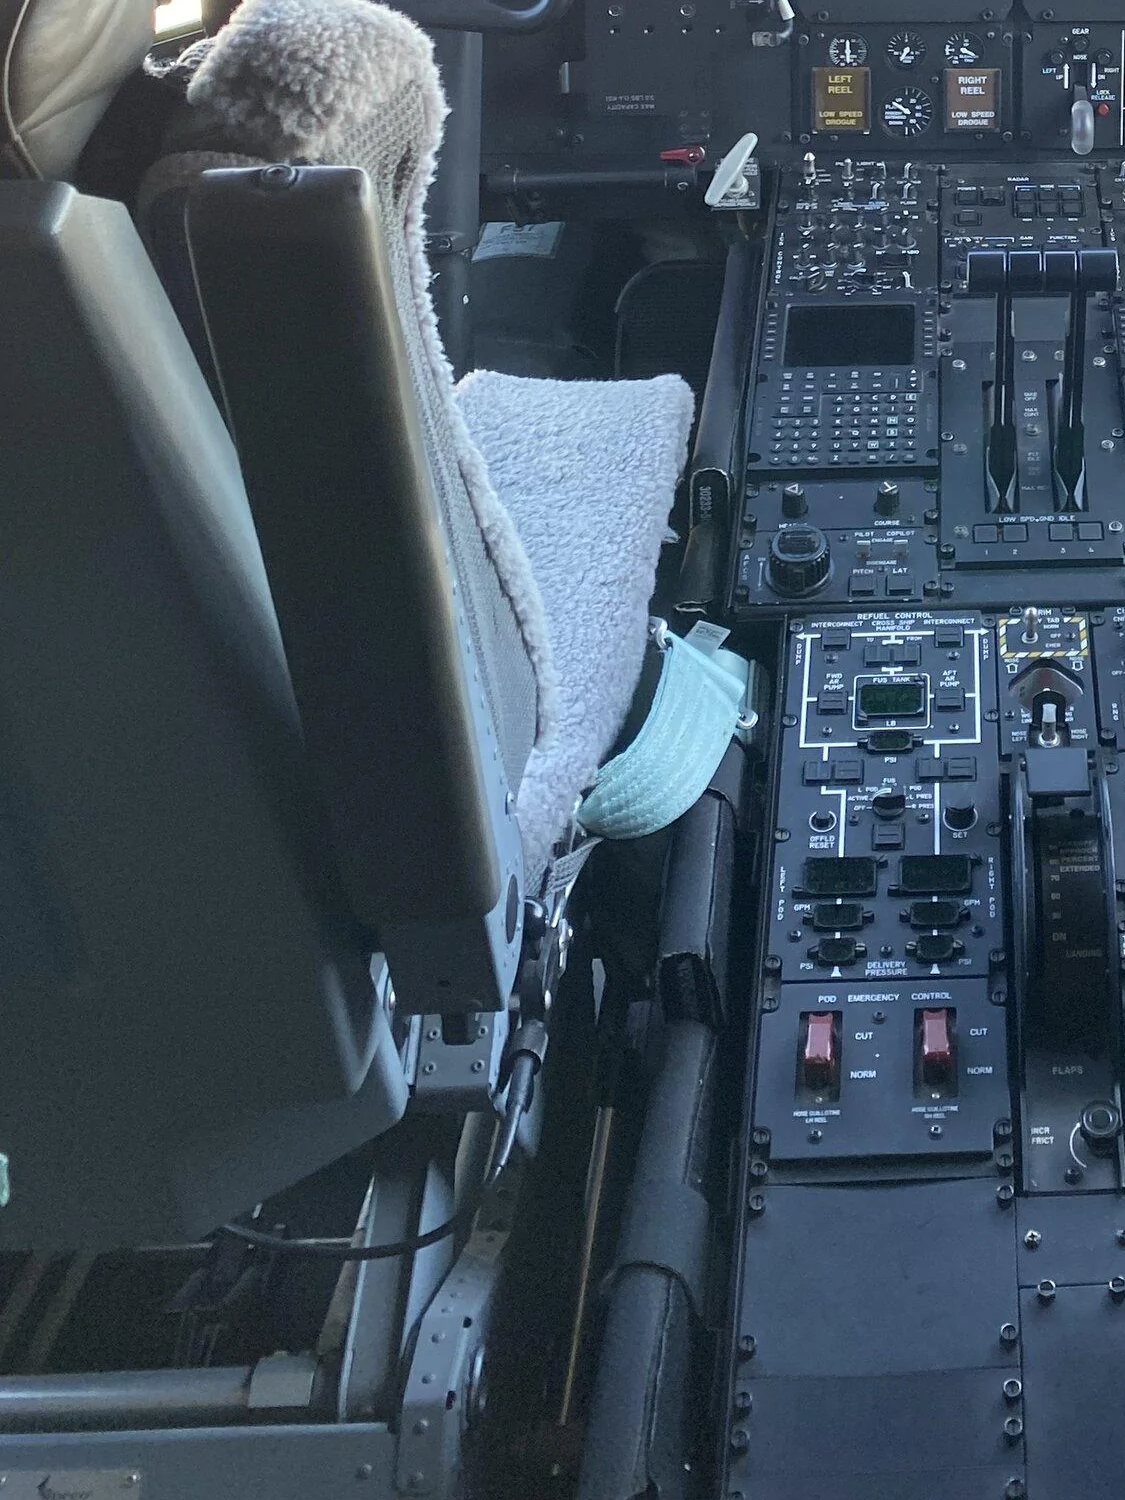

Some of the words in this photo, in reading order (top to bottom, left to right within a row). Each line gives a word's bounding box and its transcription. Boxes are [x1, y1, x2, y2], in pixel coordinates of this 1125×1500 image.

[1071, 27, 1090, 35] GEAR
[828, 75, 853, 84] LEFT
[957, 76, 988, 85] RIGHT
[828, 85, 853, 94] REEL
[960, 86, 986, 95] REEL
[819, 110, 836, 118] LOW
[839, 110, 863, 118] SPEED
[825, 118, 856, 126] DROGUE
[957, 118, 989, 126] DROGUE
[894, 612, 933, 620] CONTROL
[923, 618, 975, 626] INTERCONNECT
[809, 835, 835, 843] OFFLD
[963, 899, 981, 907] GPM
[793, 904, 811, 912] GPM
[1052, 932, 1067, 942] DN
[800, 962, 814, 970] PSI
[867, 961, 906, 969] DELIVERY
[865, 968, 908, 976] PRESSURE
[817, 995, 837, 1003] POD
[847, 993, 900, 1003] EMERGENCY
[911, 992, 952, 1000] CONTROL
[854, 1032, 874, 1040] CUT
[969, 1028, 988, 1036] CUT
[850, 1070, 877, 1079] NORM
[966, 1066, 993, 1075] NORM
[1052, 1065, 1084, 1076] FLAPS
[1030, 1127, 1050, 1135] INCR
[1031, 1136, 1055, 1145] FRICT
